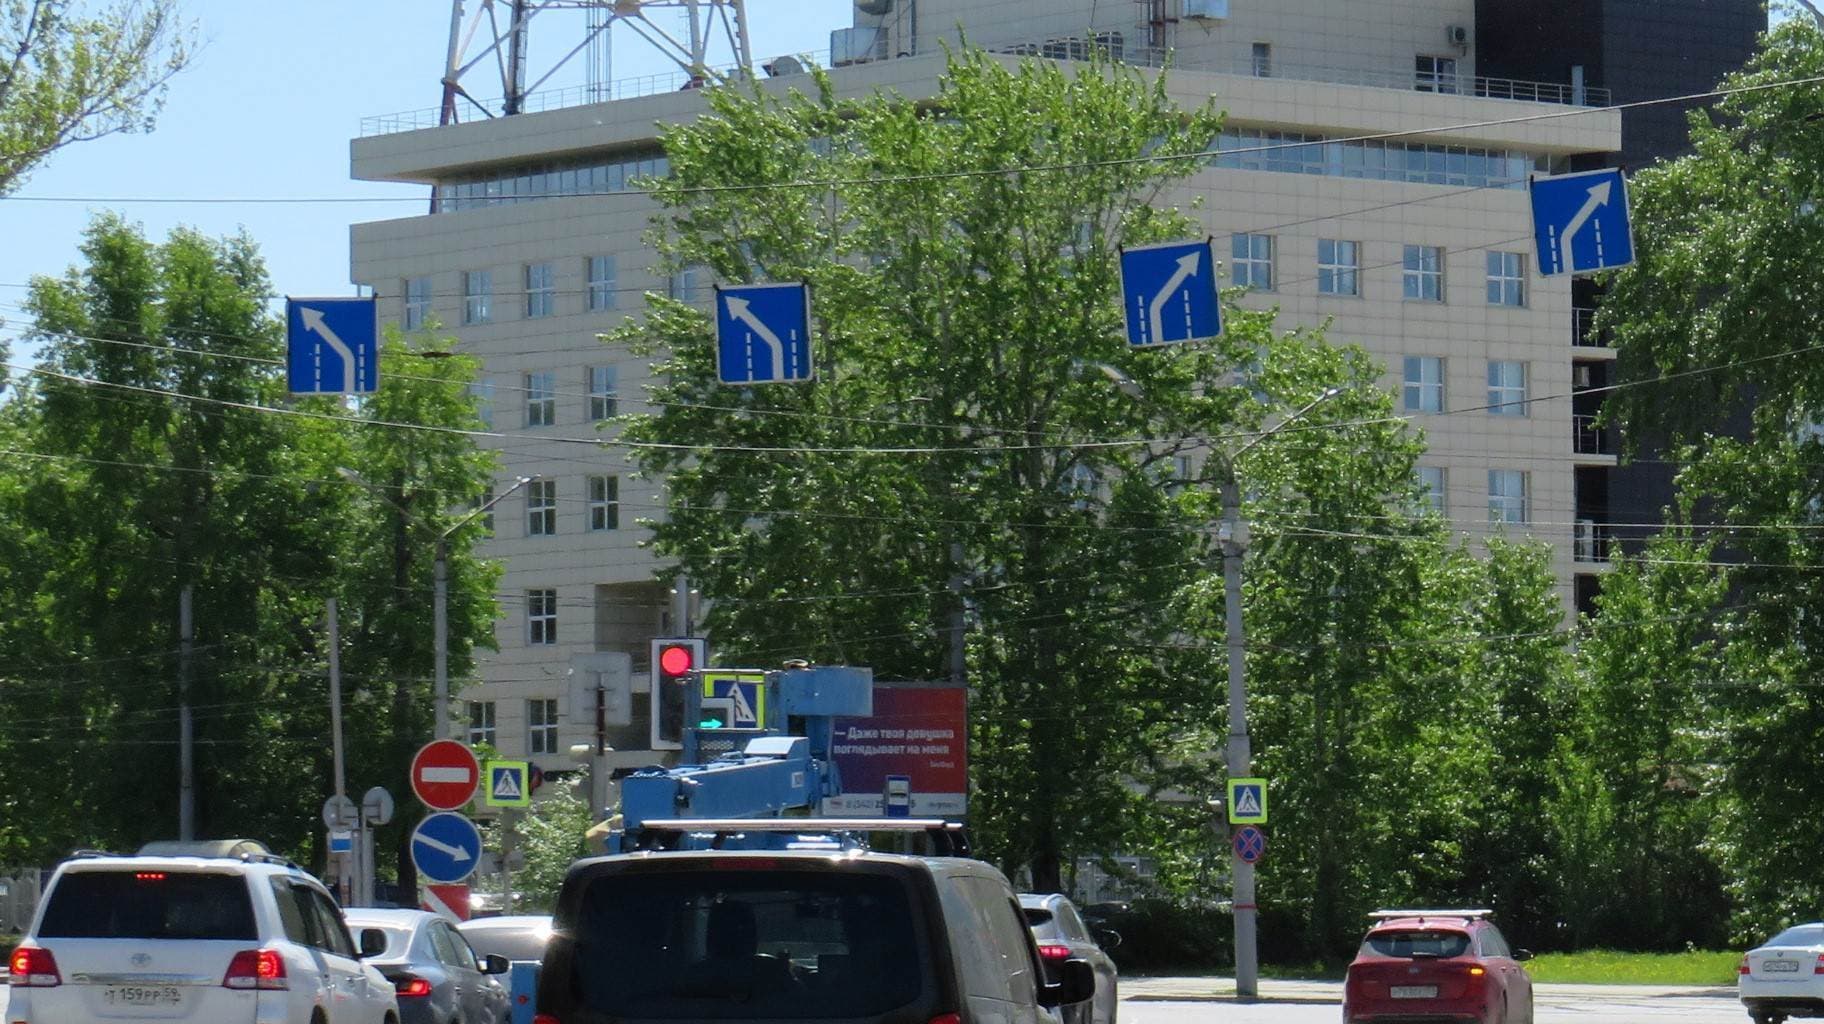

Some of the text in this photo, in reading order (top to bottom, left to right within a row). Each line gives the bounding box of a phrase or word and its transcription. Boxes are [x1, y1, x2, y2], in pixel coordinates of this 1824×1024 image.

[848, 727, 878, 740] Даже
[880, 729, 905, 739] твоя
[906, 728, 954, 740] девушка
[834, 744, 949, 755] поглядывает на меня
